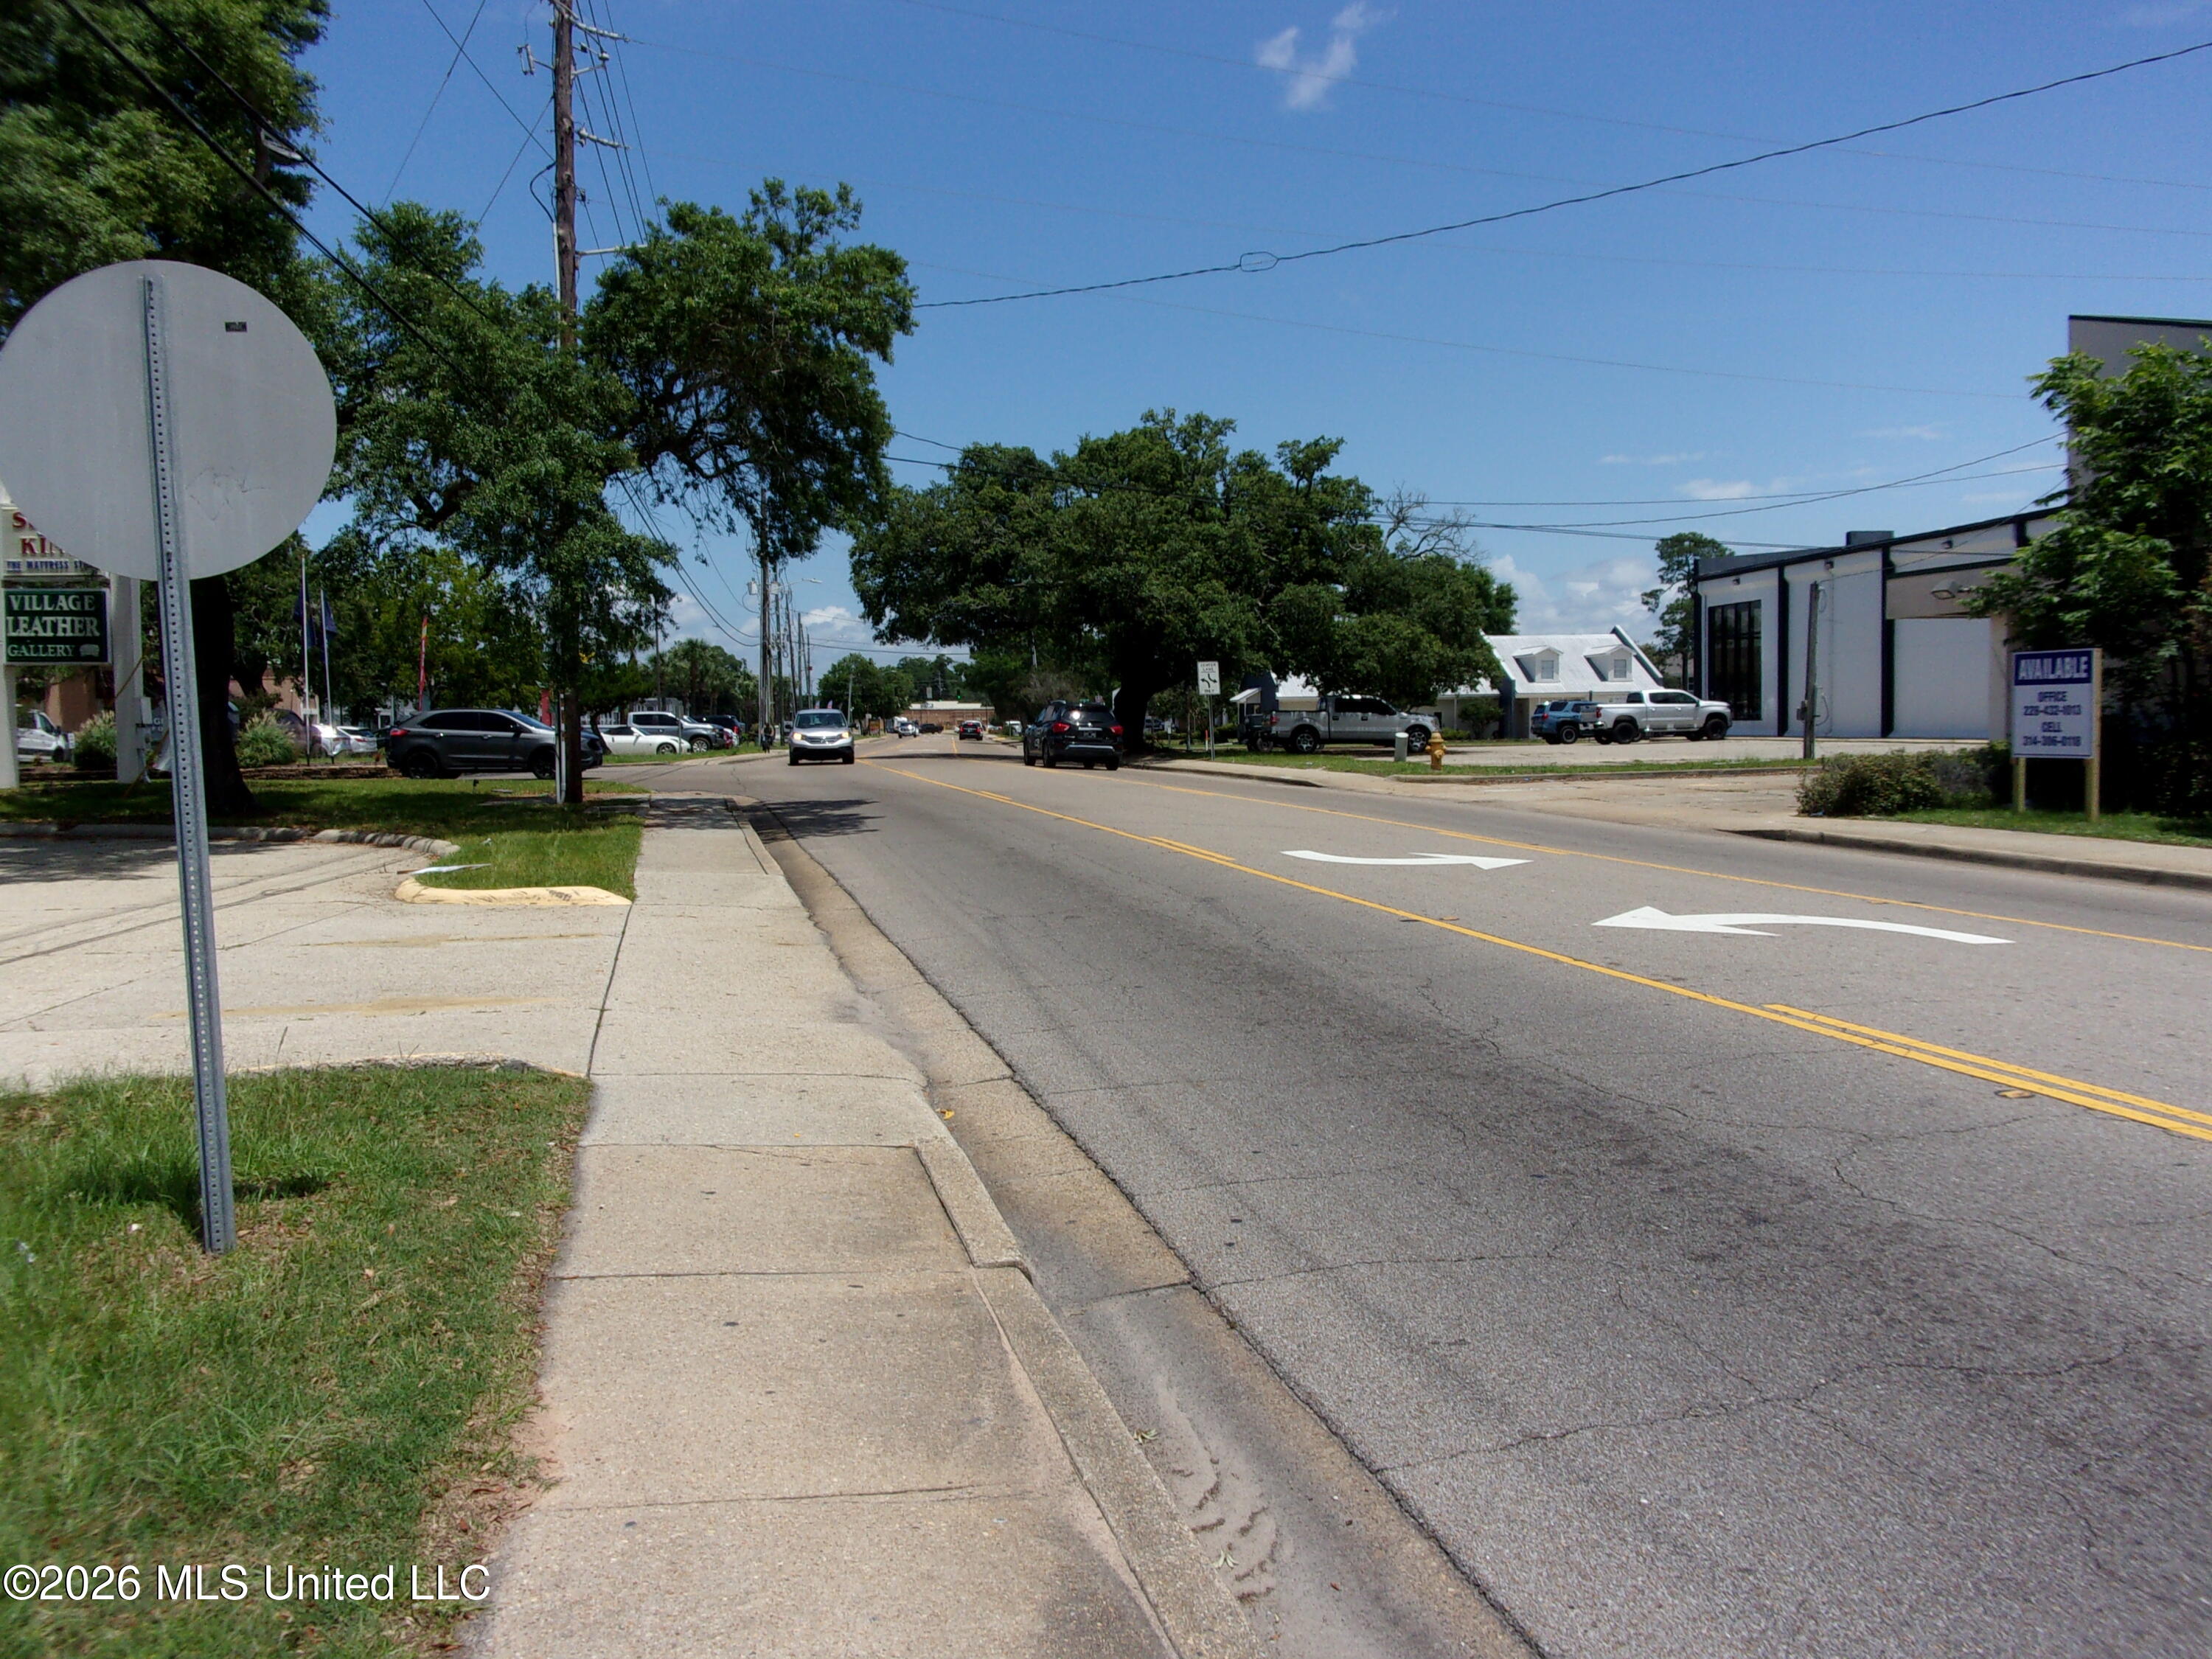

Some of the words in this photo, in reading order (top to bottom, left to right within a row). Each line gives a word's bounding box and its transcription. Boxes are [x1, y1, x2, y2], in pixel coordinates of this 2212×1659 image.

[26, 560, 69, 570] MATTRESS
[9, 594, 95, 611] VILLAGE
[6, 616, 100, 637] LEATHER
[7, 644, 75, 657] GALLERY
[2018, 655, 2089, 680] AVAILABLE
[2037, 691, 2067, 702] OFFICE
[2042, 722, 2063, 732] CELL
